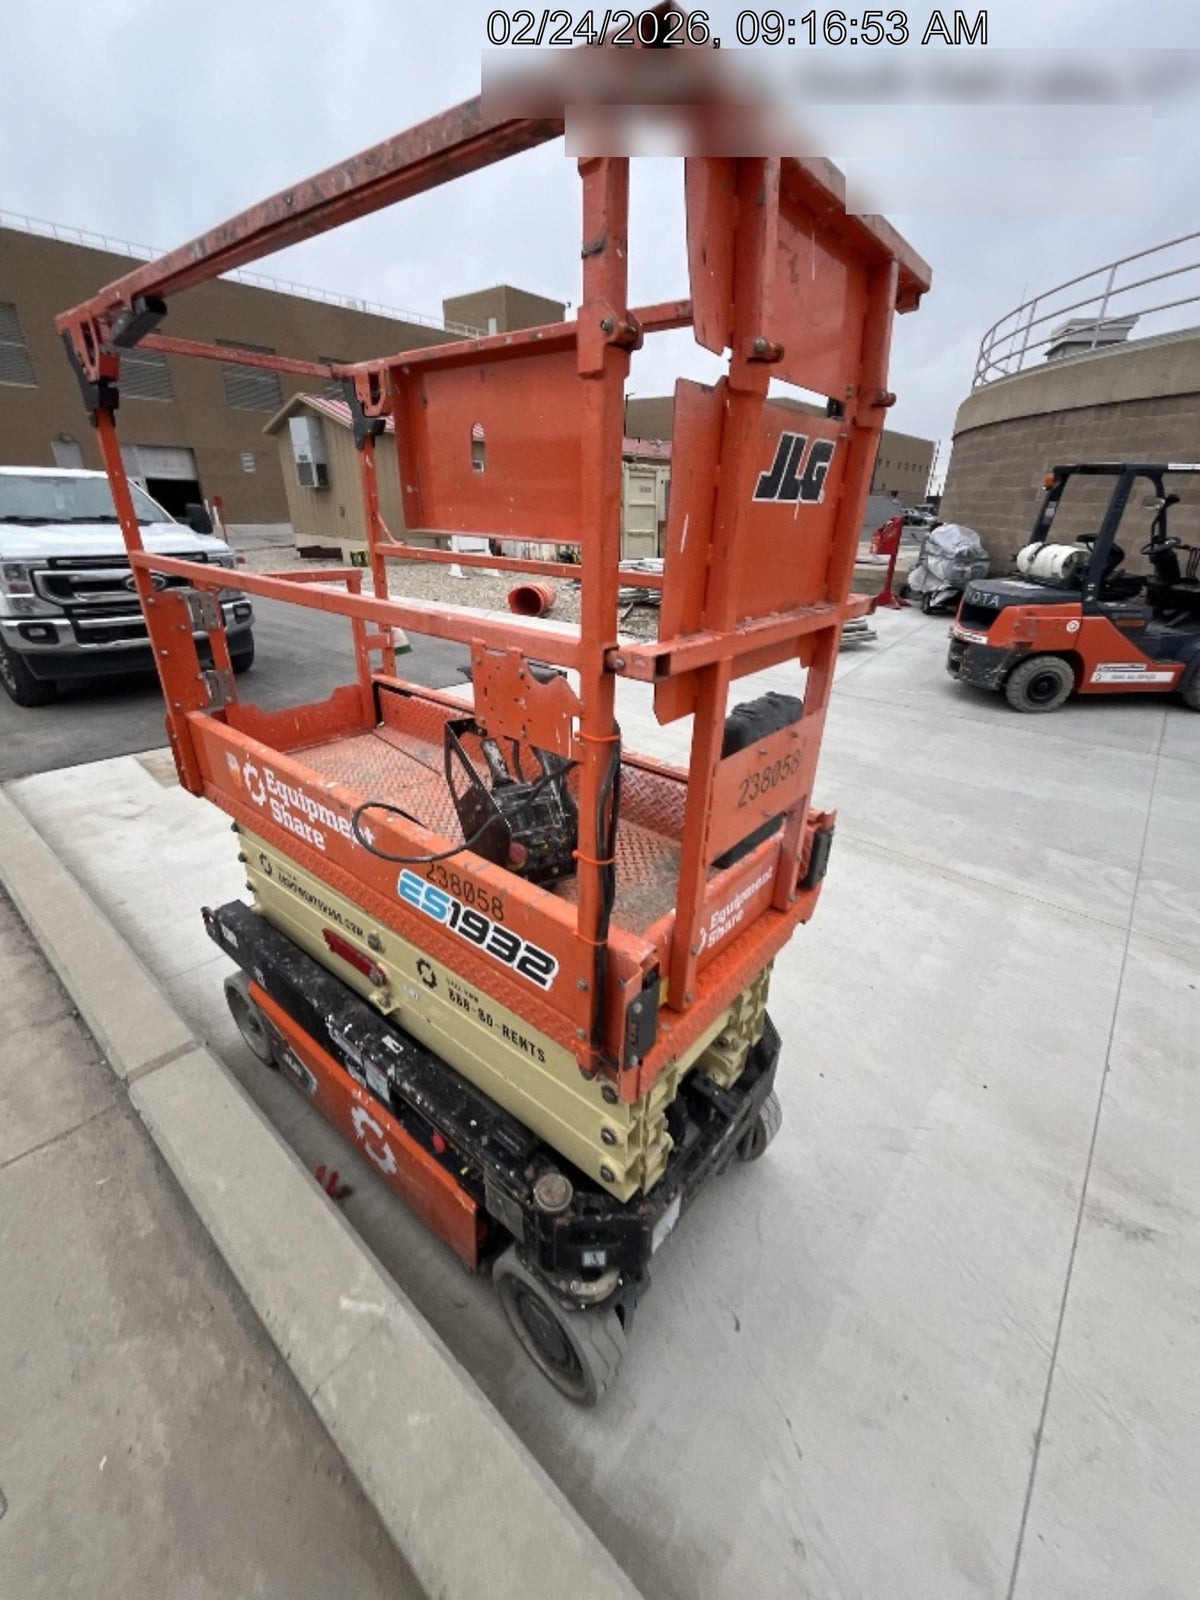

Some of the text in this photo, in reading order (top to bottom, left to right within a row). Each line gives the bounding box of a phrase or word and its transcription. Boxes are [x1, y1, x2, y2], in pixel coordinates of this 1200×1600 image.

[753, 430, 836, 504] JLG
[737, 748, 801, 807] 238058
[269, 797, 326, 850] Share
[425, 861, 504, 922] 238058
[399, 870, 558, 991] ES1932
